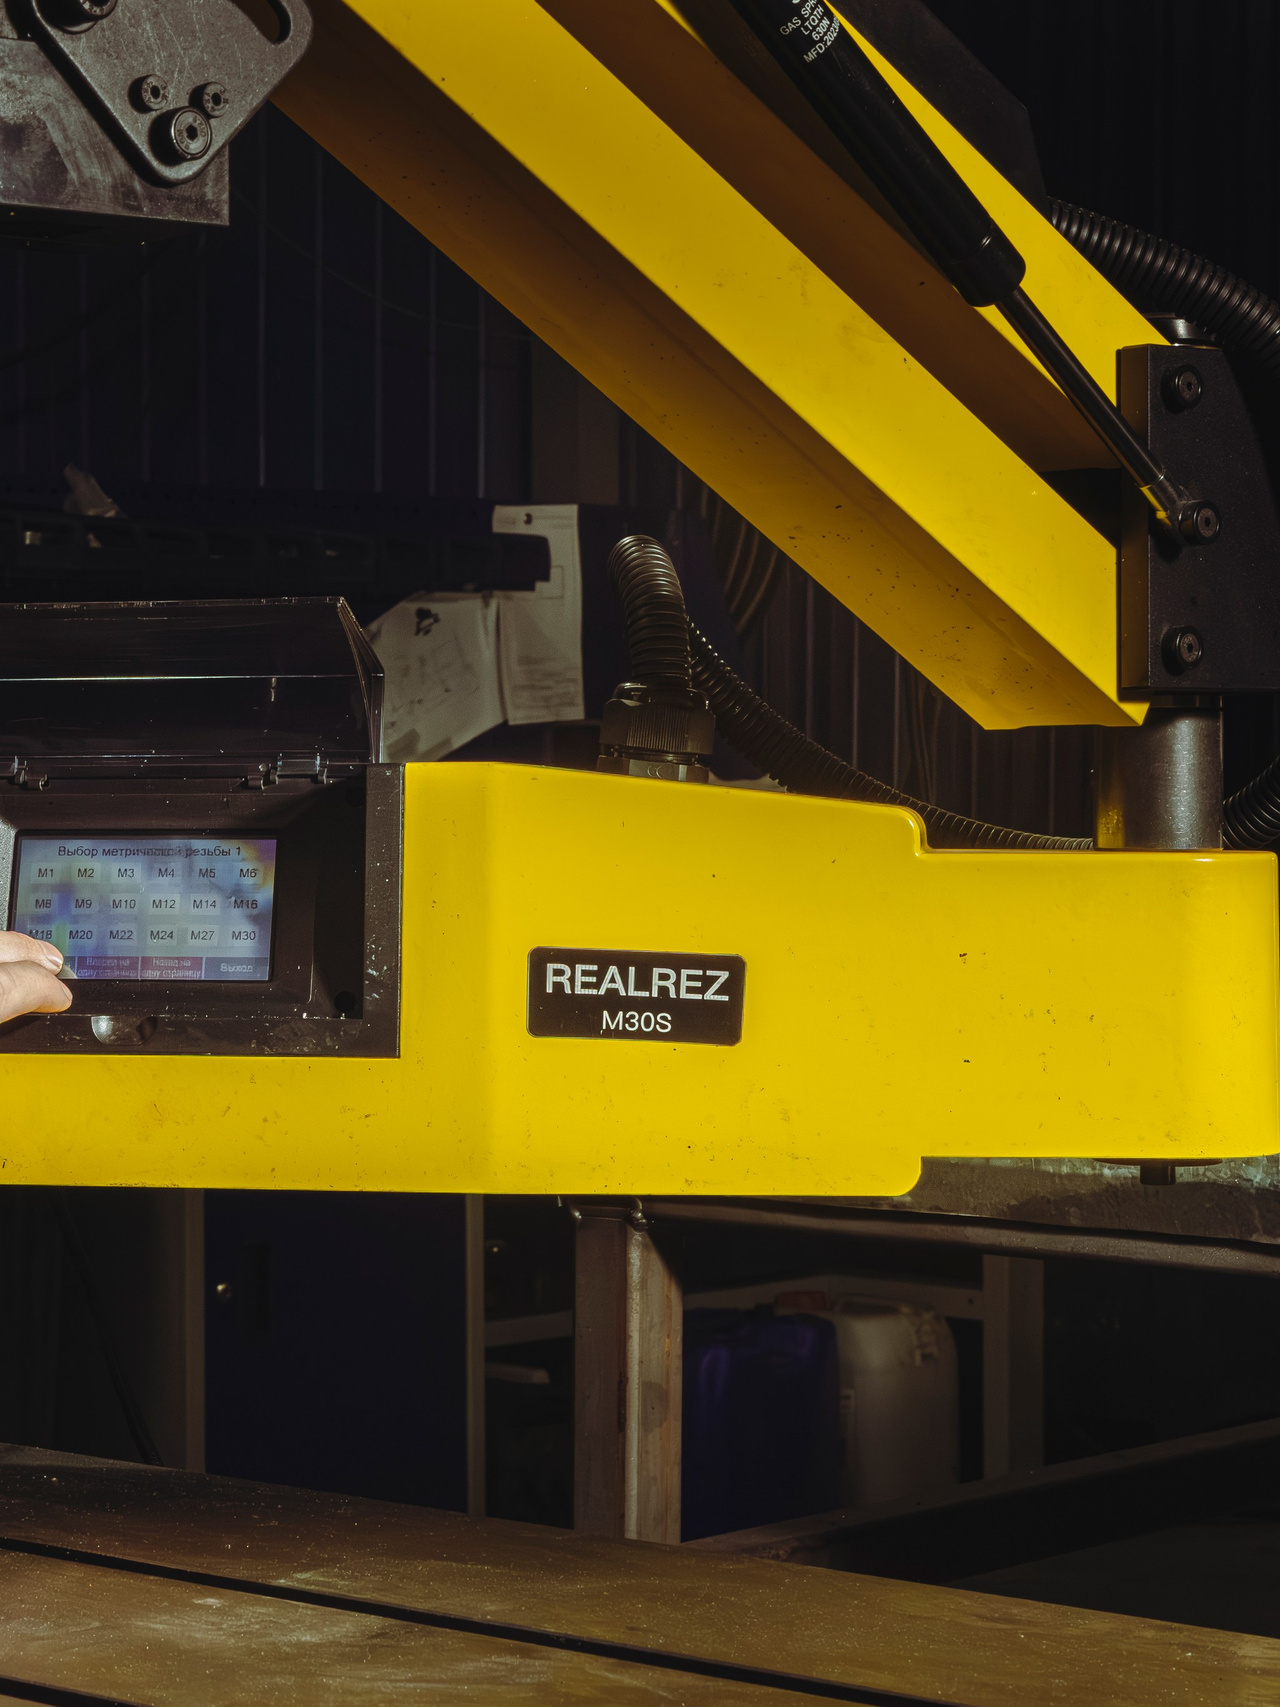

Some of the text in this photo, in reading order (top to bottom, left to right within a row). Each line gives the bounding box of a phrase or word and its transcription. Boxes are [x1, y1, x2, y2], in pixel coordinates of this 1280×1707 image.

[780, 0, 818, 35] GAS SPR
[811, 16, 831, 41] 630N
[58, 845, 99, 859] Выбор
[184, 845, 231, 858] резьбы
[235, 846, 241, 856] 1
[37, 867, 258, 878] M1 M2 M3 M4 M5 M6
[35, 899, 258, 909] M8 M9 M10 M12 M14 M16
[68, 930, 93, 940] M20
[109, 930, 134, 940] M22
[150, 930, 174, 940] M24
[190, 930, 215, 940] M27
[231, 930, 256, 940] M30
[545, 962, 730, 1002] REALREZ
[602, 1010, 672, 1033] M30S
